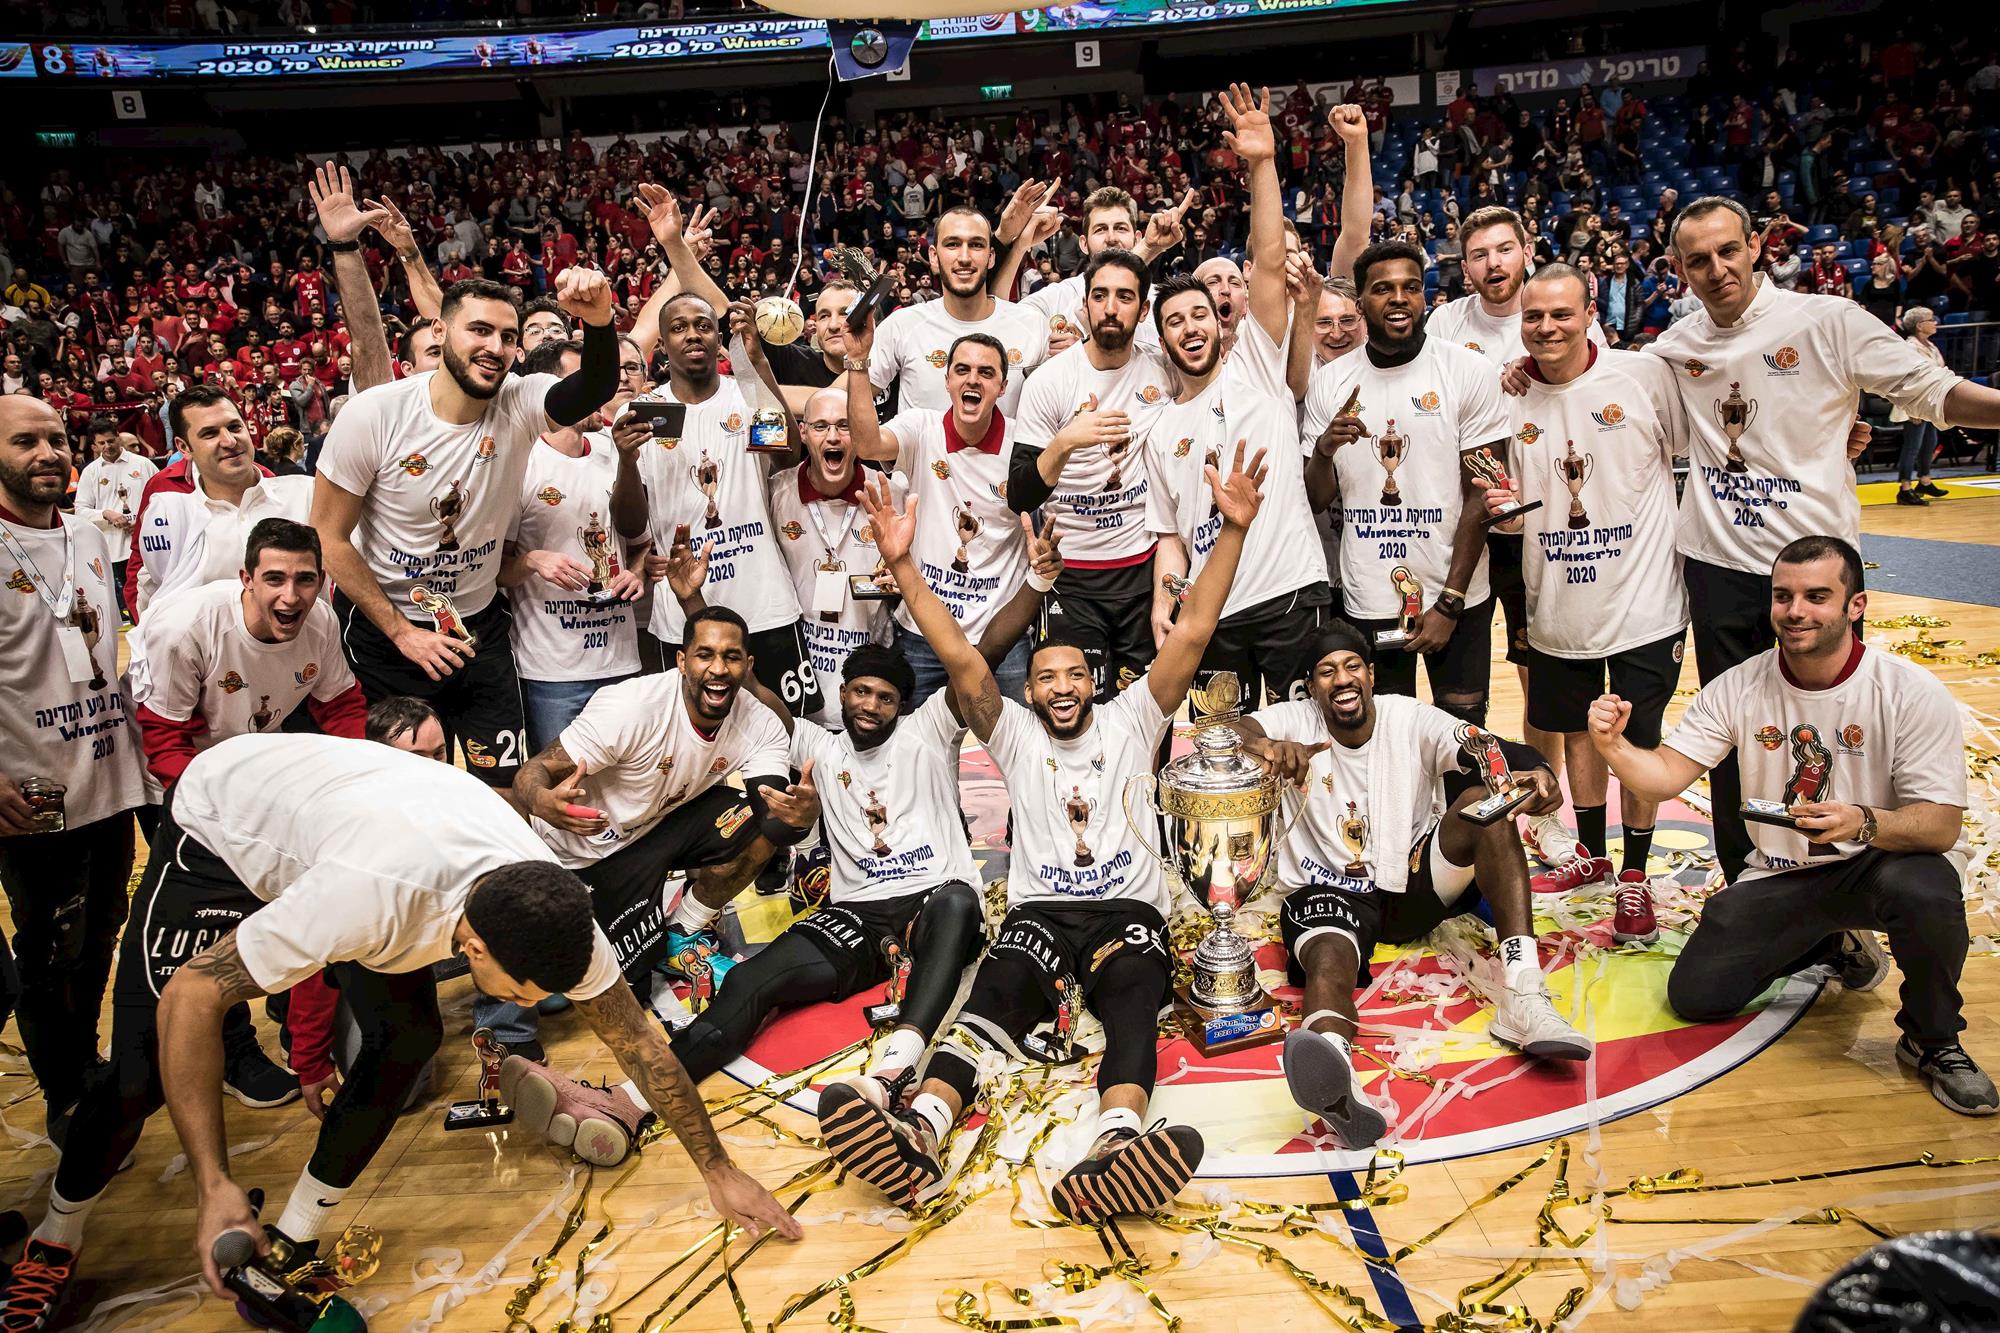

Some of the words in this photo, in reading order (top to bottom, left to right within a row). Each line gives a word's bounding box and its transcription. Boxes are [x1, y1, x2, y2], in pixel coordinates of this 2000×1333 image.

[1149, 5, 1216, 22] 2020
[1223, 3, 1250, 15] סל
[639, 25, 707, 39] המדינה
[714, 22, 757, 34] גביע
[760, 20, 827, 34] מחזיקת
[930, 24, 978, 36] מבטחים
[226, 43, 300, 55] המדינה
[308, 42, 354, 54] גביע
[359, 40, 436, 54] מחזיקת
[614, 42, 681, 58] 2020
[688, 41, 715, 53] סל
[720, 37, 802, 49] Winner
[42, 46, 67, 75] 8
[316, 56, 405, 69] Winner
[1082, 47, 1093, 62] 9
[198, 60, 273, 74] 2020
[281, 59, 310, 72] סל
[1600, 56, 1681, 83] טריפל
[122, 96, 136, 113] 8
[1095, 512, 1123, 529] 2020
[1344, 508, 1377, 524] המדינה
[1380, 508, 1402, 524] גביע
[1406, 508, 1442, 526] מחזיקת
[1733, 508, 1765, 528] 2020
[729, 520, 764, 544] מחזיקת
[1355, 524, 1416, 539] Winner
[1566, 530, 1589, 548] גביע
[1594, 523, 1633, 547] מחזיקת
[389, 547, 430, 567] המדינה
[1379, 542, 1407, 559] 2020
[1545, 548, 1606, 562] Winner
[708, 562, 735, 583] 2020
[945, 570, 967, 588] גביע
[1566, 565, 1597, 584] 2020
[426, 579, 457, 593] 2020
[967, 576, 1000, 592] מחזיקת
[560, 615, 612, 630] Winner
[583, 631, 609, 649] 2020
[816, 627, 834, 642] גביע
[837, 627, 871, 645] מחזיקת
[812, 655, 836, 673] 2020
[780, 660, 820, 702] 69
[35, 701, 84, 729] המדינה
[898, 844, 935, 867] מחזיקת
[1074, 869, 1099, 885] גביע
[1300, 856, 1338, 882] המדינה
[1053, 881, 1112, 897] Winner
[1338, 876, 1364, 893] גביע
[1295, 902, 1361, 928] LUCIANA
[1504, 937, 1521, 967] PEAK
